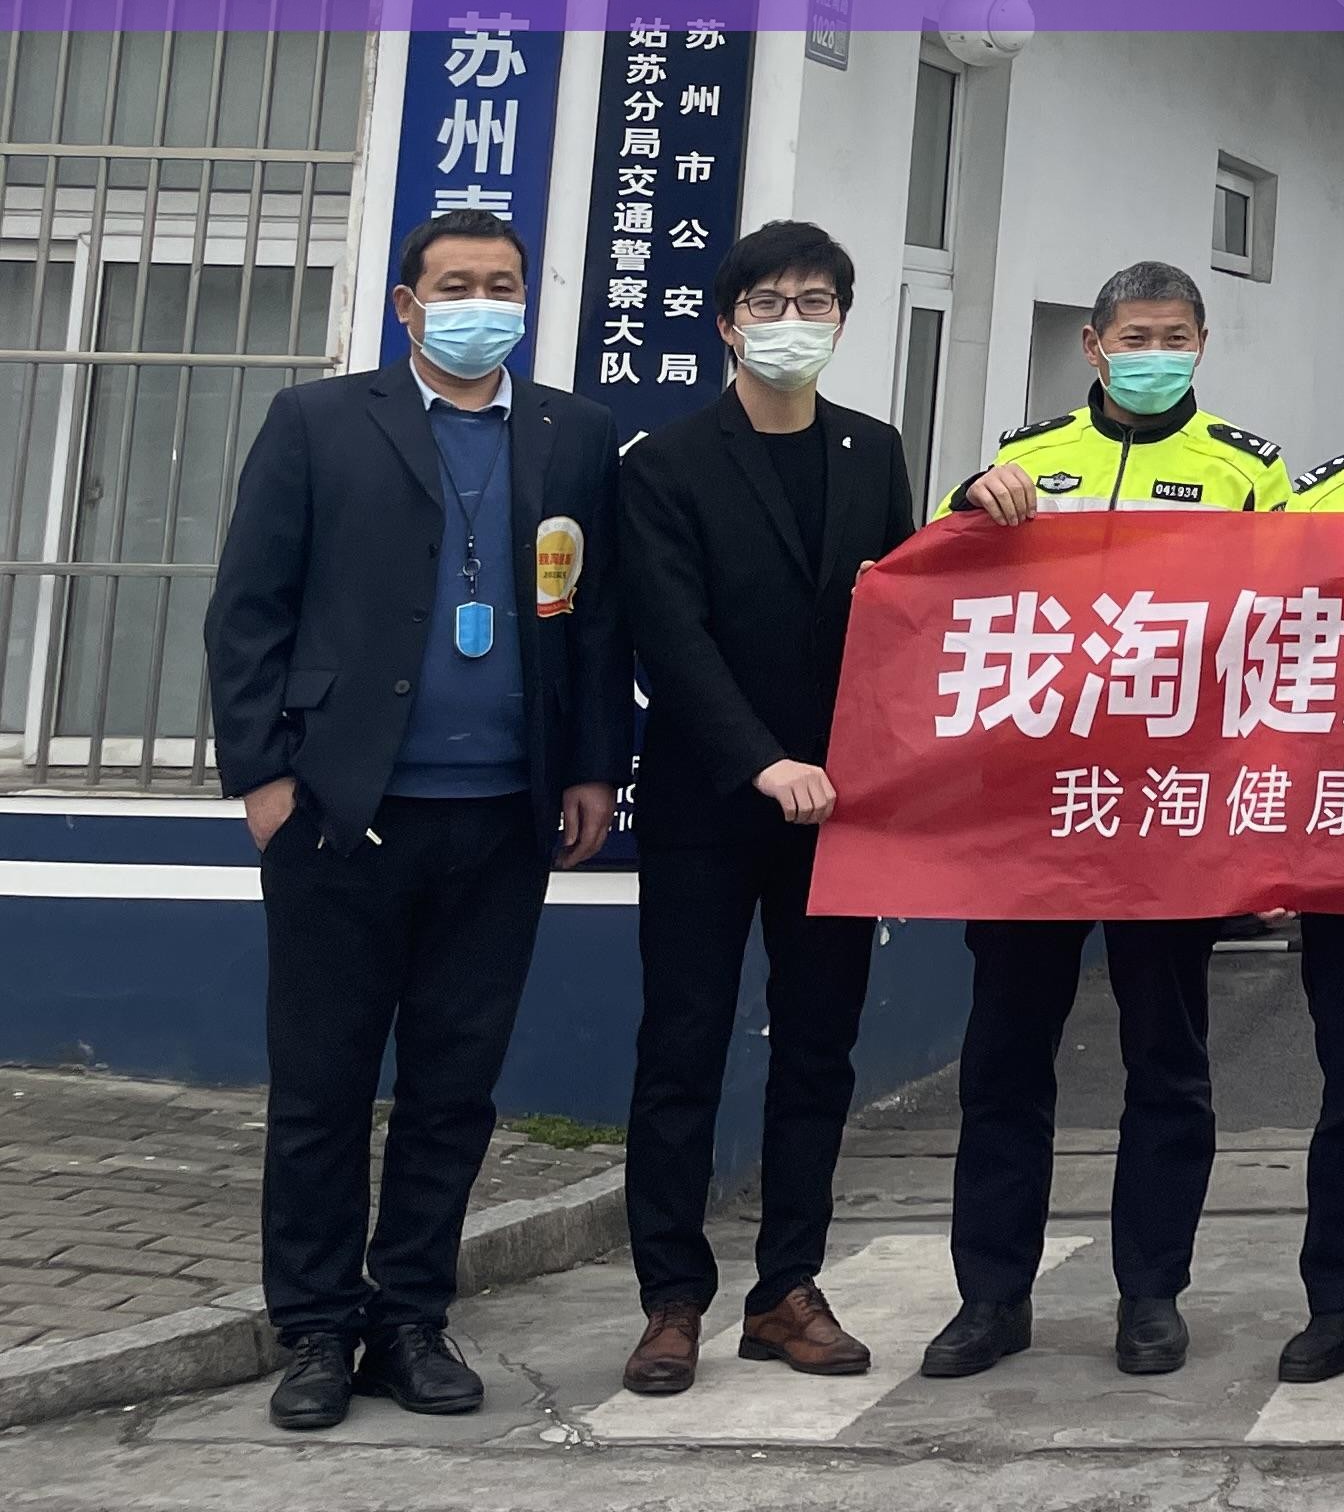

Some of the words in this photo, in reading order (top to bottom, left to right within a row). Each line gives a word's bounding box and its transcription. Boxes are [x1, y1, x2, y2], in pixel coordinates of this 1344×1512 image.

[599, 17, 670, 385] 姑苏分局交通警察大队
[656, 18, 726, 386] 苏州市公安局
[1155, 483, 1199, 499] 041934
